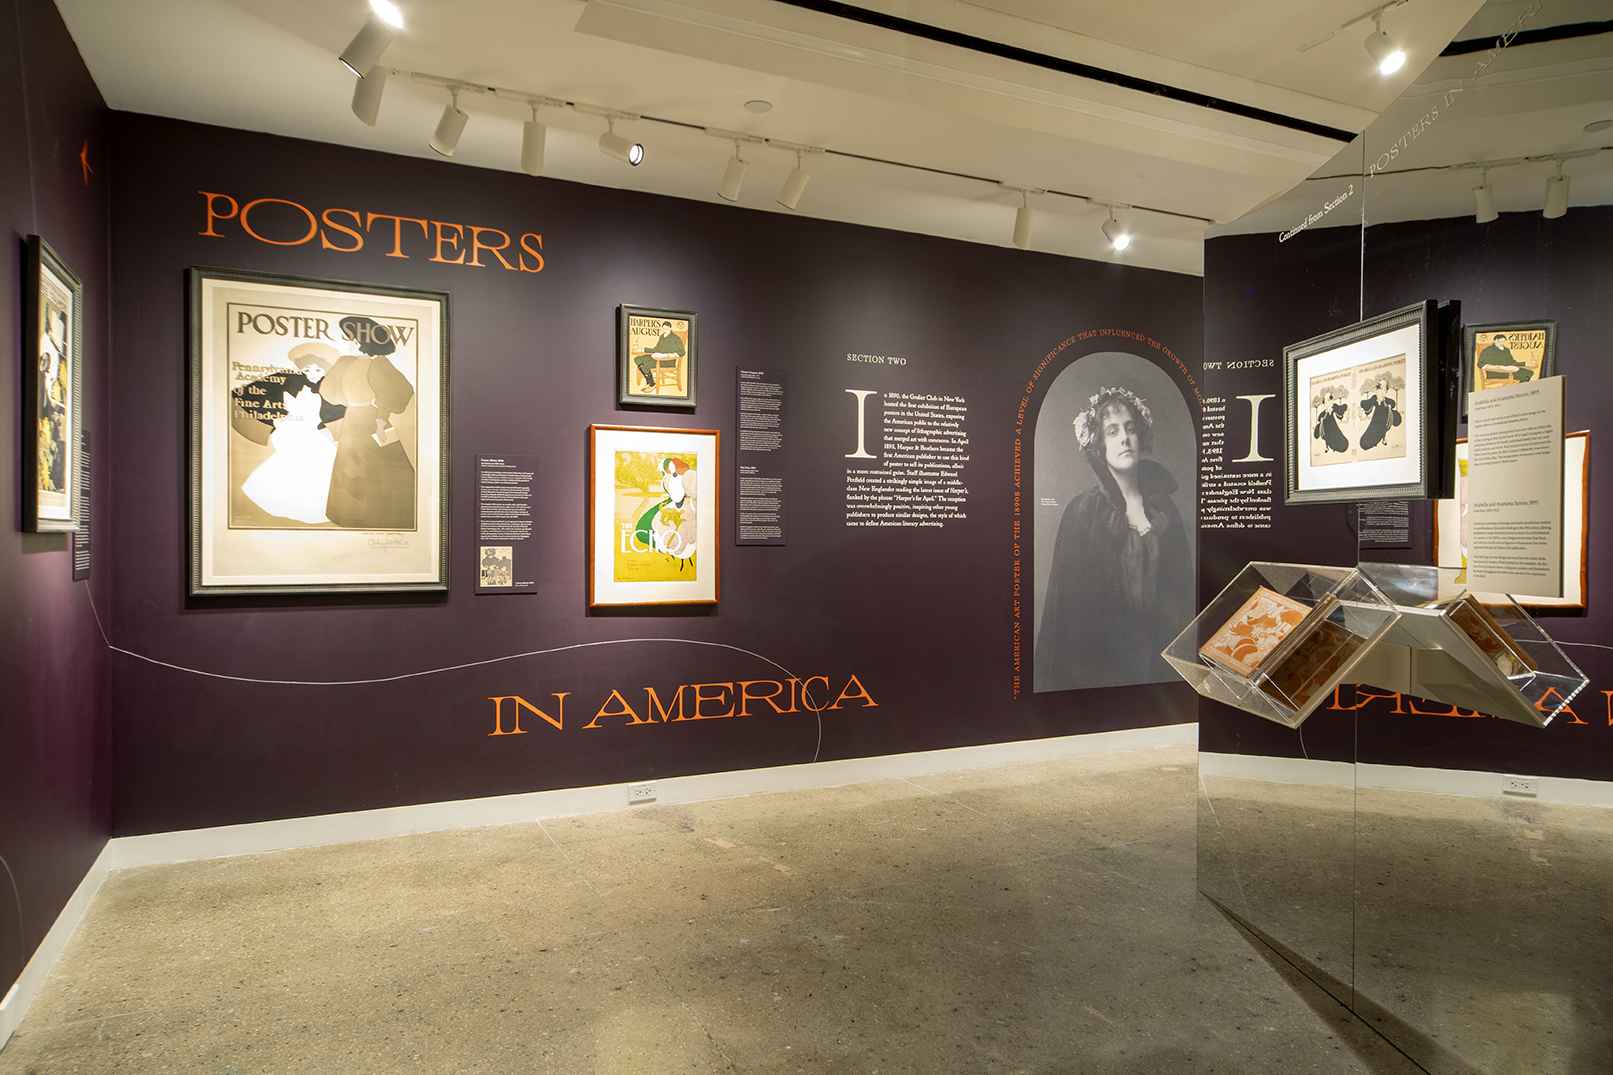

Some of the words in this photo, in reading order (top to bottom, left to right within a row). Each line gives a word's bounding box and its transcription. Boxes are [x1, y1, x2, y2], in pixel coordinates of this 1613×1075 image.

[1369, 106, 1440, 179] POSTERS
[1444, 78, 1465, 108] IN
[1279, 218, 1308, 243] Continued
[1308, 211, 1323, 225] from
[1324, 192, 1347, 214] Section
[1348, 184, 1354, 196] 2
[198, 190, 544, 273] POSTERS
[237, 312, 334, 341] POSTER
[342, 322, 414, 346] SHOW
[630, 318, 661, 327] HARPER'S
[630, 327, 660, 336] AUGUST
[232, 362, 302, 375] Pennsylvania
[847, 353, 884, 364] SECTION
[887, 357, 907, 366] TWO
[233, 385, 247, 396] of
[248, 385, 267, 395] the
[235, 372, 286, 385] Academy
[235, 398, 259, 407] Fine
[263, 400, 286, 409] Arts
[845, 389, 878, 458] I
[1014, 543, 1020, 556] OF
[1017, 396, 1029, 426] LEVEL
[1026, 381, 1035, 394] OF
[1033, 336, 1076, 380] SIGNIFICANCE
[1077, 330, 1097, 340] THAT
[1100, 329, 1145, 342] INFLUENCED
[1147, 338, 1161, 349] THE
[1162, 347, 1188, 374] GROWTH
[1187, 374, 1196, 385] OF
[621, 529, 682, 553] ECHO
[487, 692, 571, 736] IN
[582, 675, 879, 729] AMERICA
